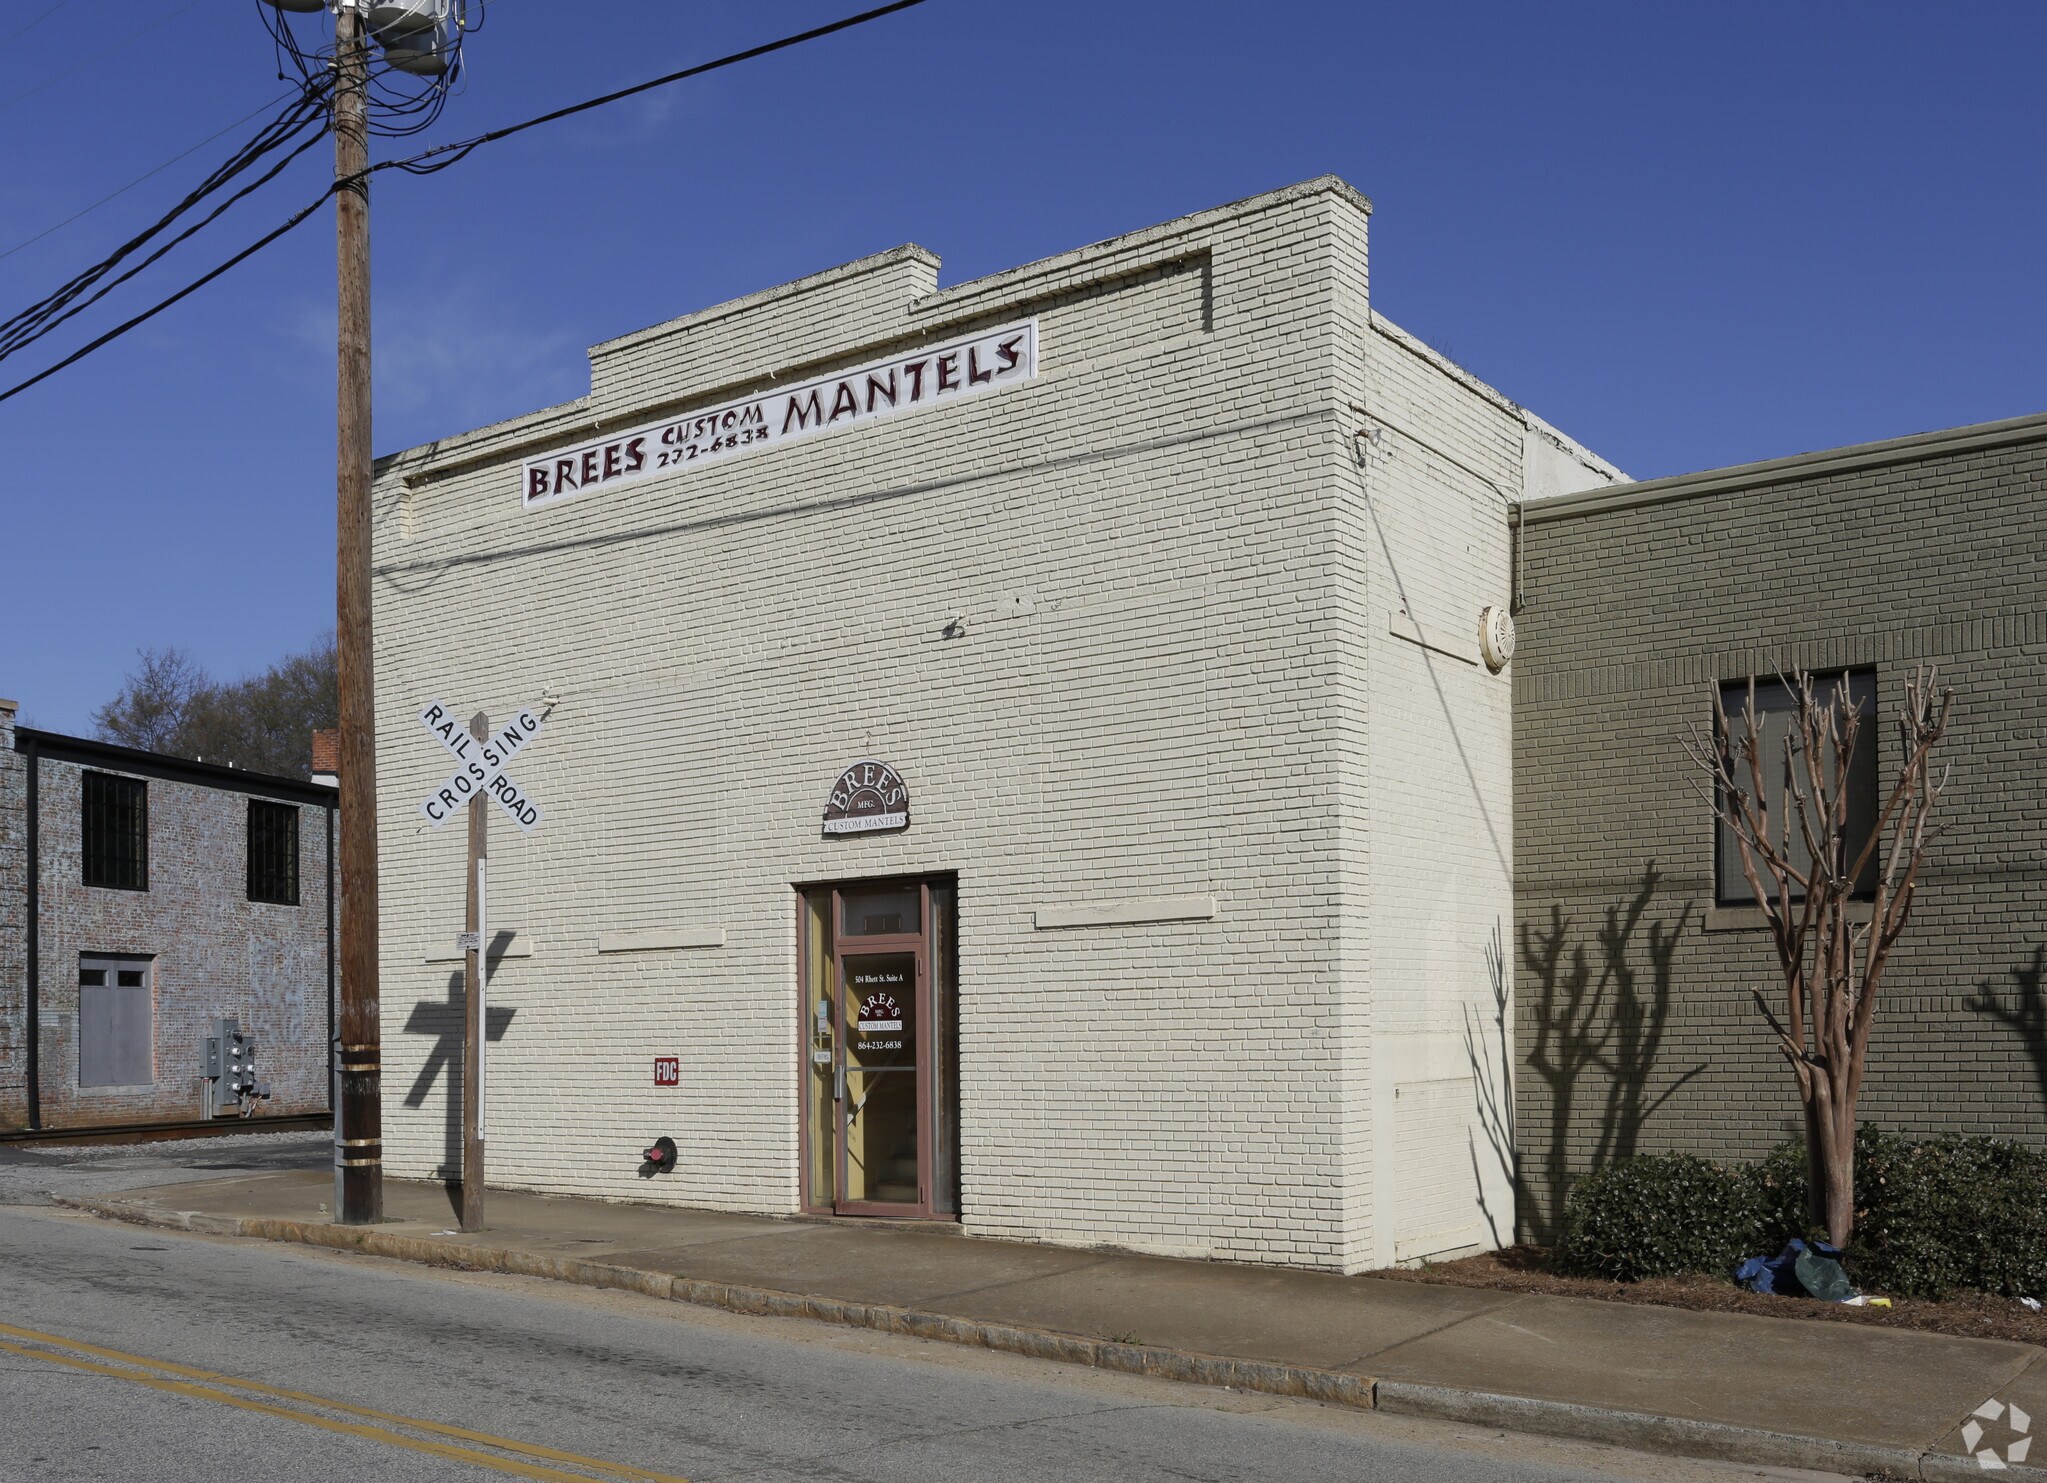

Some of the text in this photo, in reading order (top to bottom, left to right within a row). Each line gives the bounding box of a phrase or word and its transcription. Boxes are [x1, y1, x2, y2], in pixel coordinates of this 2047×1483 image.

[528, 333, 1026, 500] BREES CUSTOM MANTELS
[656, 424, 770, 469] 232-6838
[424, 704, 538, 827] RAIL ROAD
[426, 712, 538, 821] CROSSING
[830, 763, 902, 811] BREES
[857, 800, 876, 810] MFG.
[827, 815, 904, 832] CUSTOM MANTELS
[898, 974, 904, 982] A
[859, 992, 901, 1018] BREES
[859, 1021, 902, 1030] CUSTOM MANTELS
[857, 1041, 902, 1050] 864-232-6838
[656, 1061, 677, 1081] FDC
